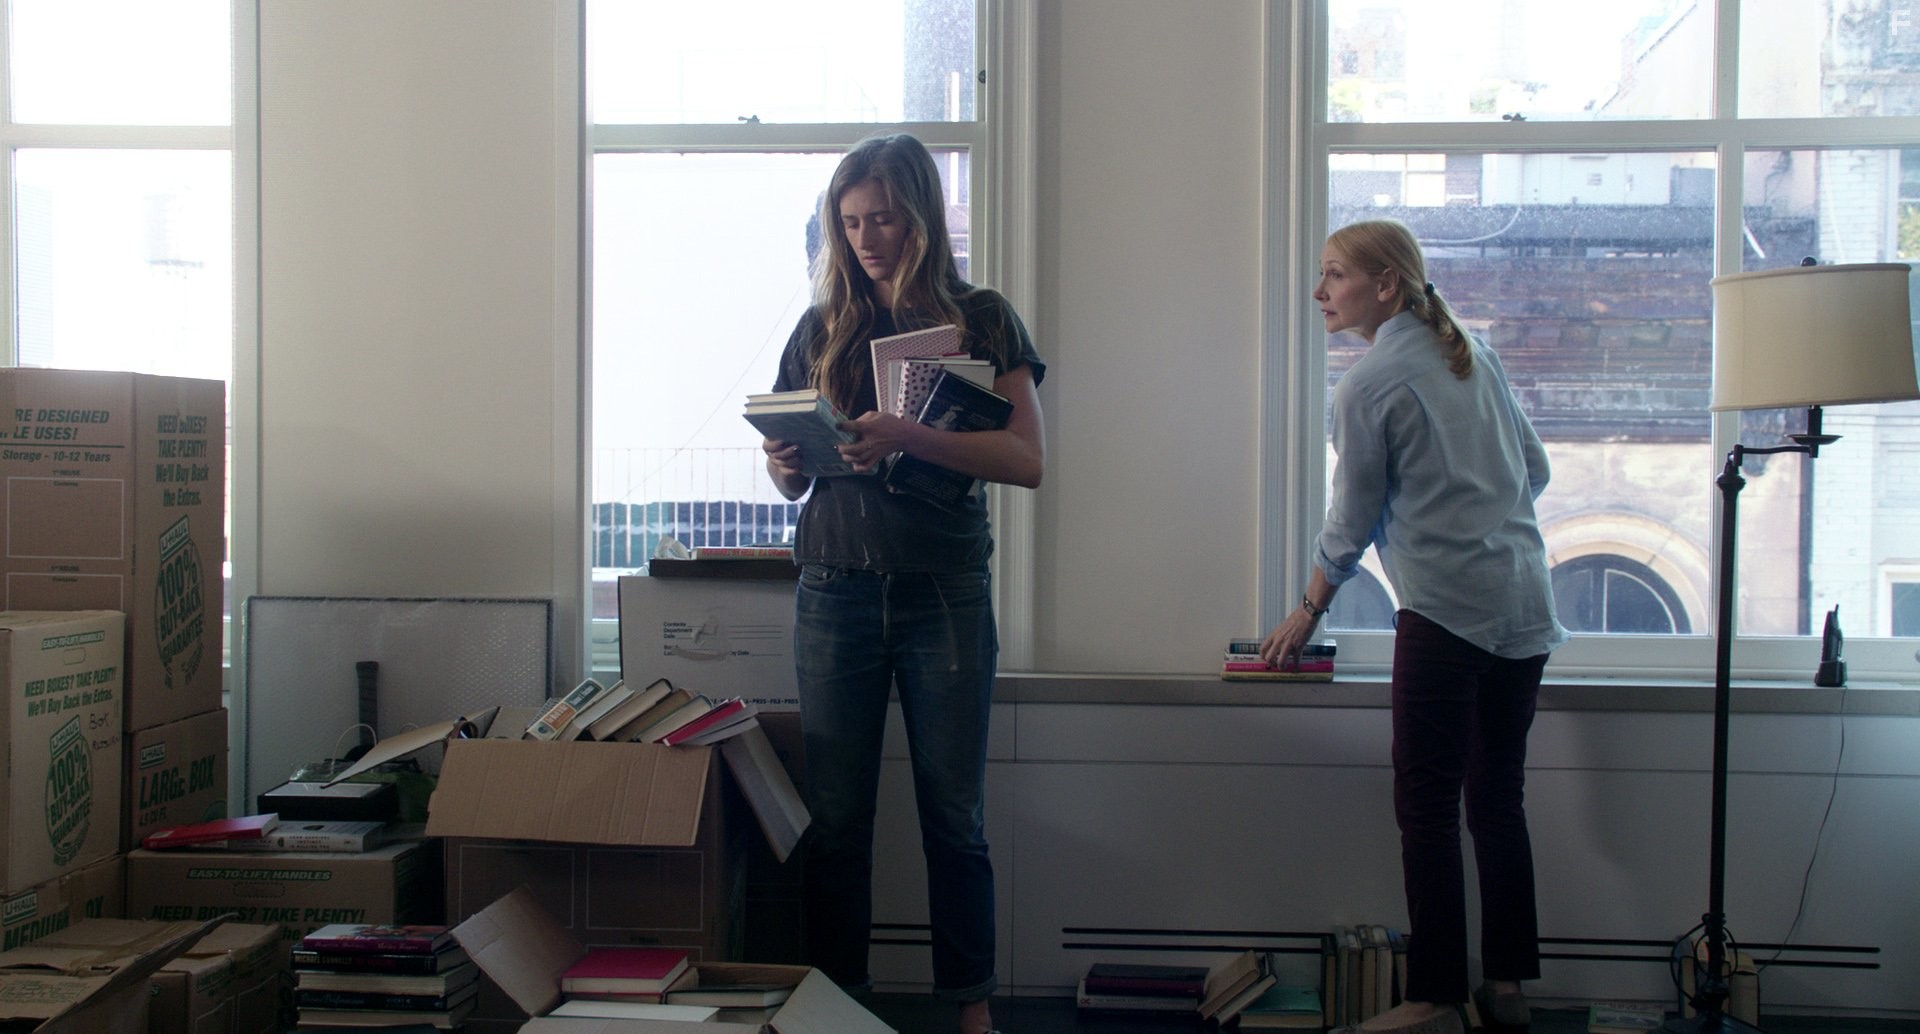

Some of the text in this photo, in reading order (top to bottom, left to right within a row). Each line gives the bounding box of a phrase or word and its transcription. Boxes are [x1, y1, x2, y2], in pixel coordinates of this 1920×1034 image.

[37, 409, 110, 424] DESIGNED
[157, 415, 177, 433] NEED
[34, 426, 79, 440] USES!
[2, 449, 42, 462] Storage
[53, 450, 81, 462] 10-12
[84, 451, 111, 462] Years
[158, 440, 207, 457] TAKE PLENTY!
[156, 464, 209, 486] We'll Buy Back
[163, 488, 202, 507] the Extras.
[162, 523, 187, 551] U-HAUL
[160, 550, 198, 610] 100%
[160, 584, 202, 641] BUY-BACK
[162, 615, 203, 663] GUARANTEE
[663, 627, 693, 635] Department
[25, 679, 45, 697] NEED
[46, 674, 75, 693] BOXES?
[76, 671, 92, 688] TAKE
[27, 699, 46, 717] We'll
[48, 697, 62, 715] Buy
[63, 693, 80, 710] Back
[81, 691, 92, 705] the
[52, 723, 79, 750] U-HAUL
[48, 744, 88, 799] 100%
[189, 754, 217, 794] BOX
[50, 777, 90, 826] BUY-BACK
[51, 801, 91, 847] GUARANTEE
[189, 868, 333, 881] EASY-TO-LIFT HANDLES
[5, 895, 36, 916] U-HAUL
[152, 905, 193, 921] NEED
[262, 906, 300, 922] TAKE
[303, 907, 365, 923] PLENTY!
